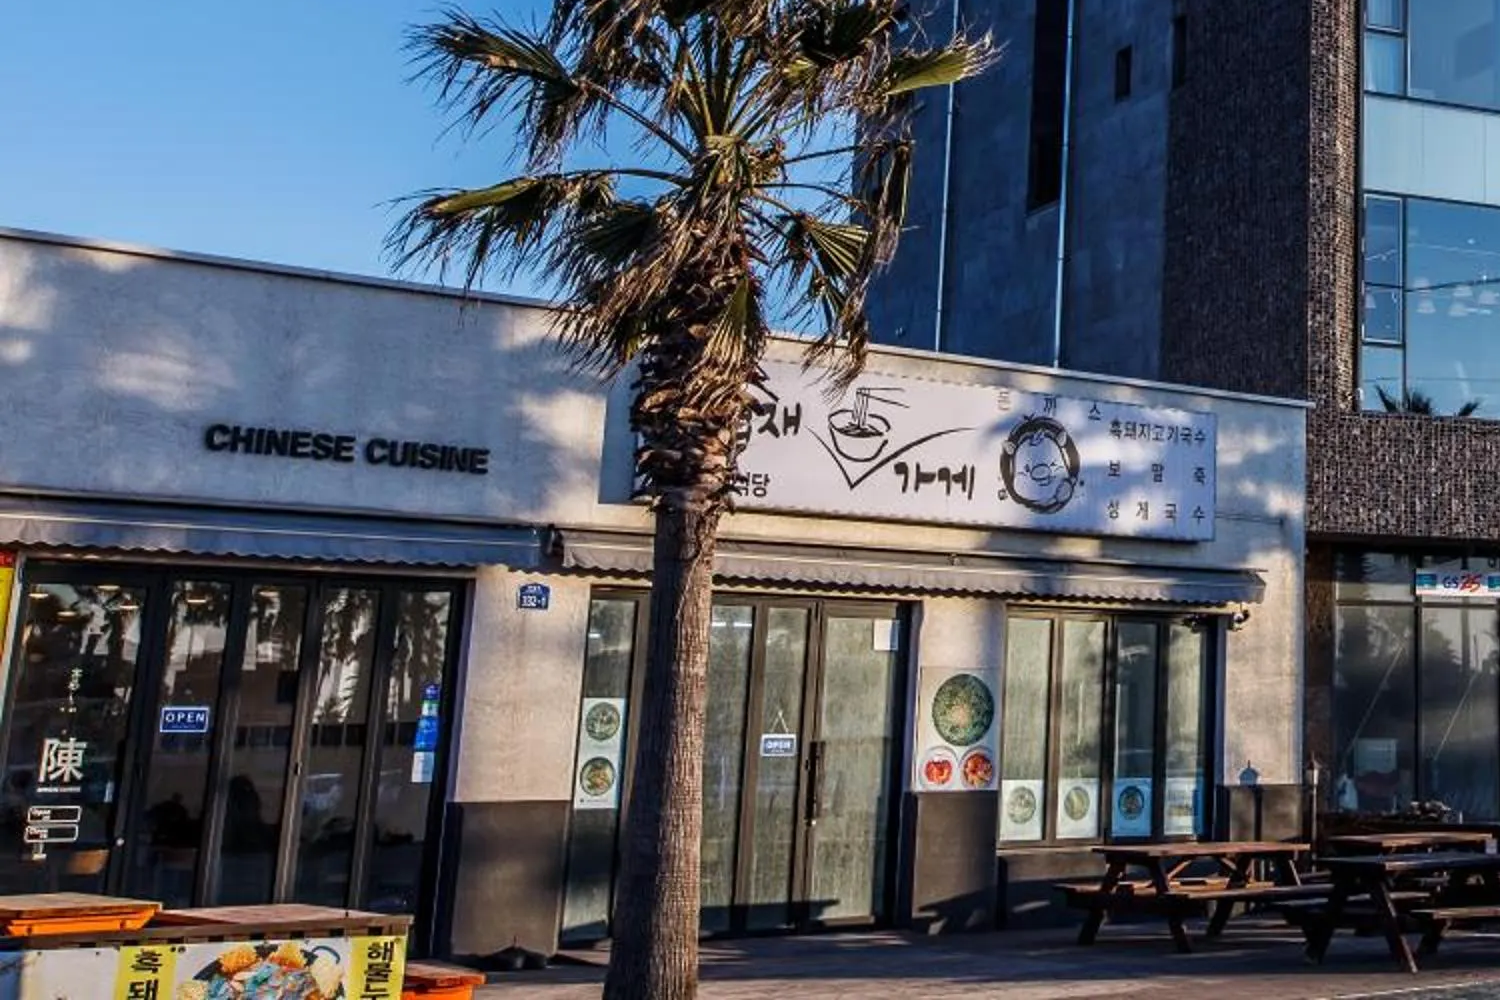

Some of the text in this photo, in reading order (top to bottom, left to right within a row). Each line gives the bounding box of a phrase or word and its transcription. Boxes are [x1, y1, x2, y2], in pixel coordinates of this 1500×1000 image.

[1110, 418, 1207, 445] 흑돼지고기국수
[205, 423, 491, 475] CHINESE CUISINE
[893, 461, 975, 500] 가게
[1442, 572, 1482, 593] GS25
[165, 711, 205, 723] OPEN
[38, 737, 88, 782] 陳
